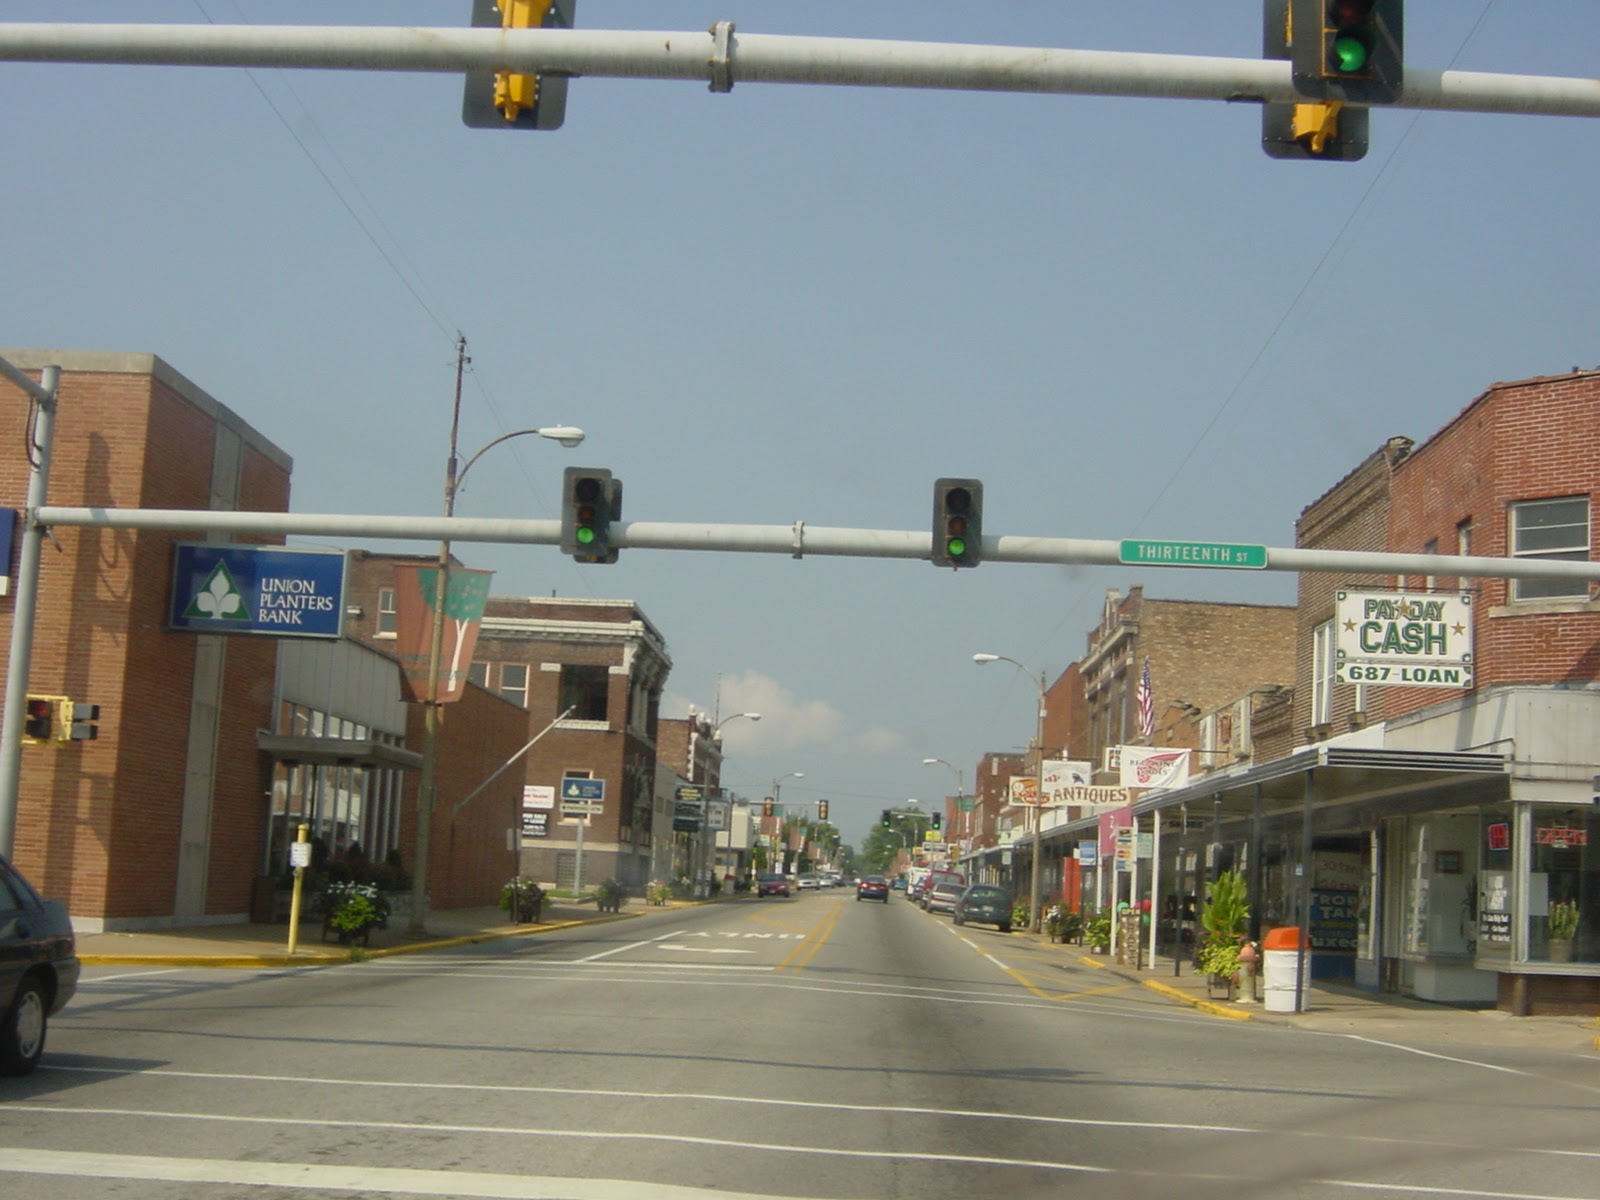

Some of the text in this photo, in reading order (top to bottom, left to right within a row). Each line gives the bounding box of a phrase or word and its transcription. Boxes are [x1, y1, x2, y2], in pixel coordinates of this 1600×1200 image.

[1138, 545, 1248, 563] THIRTEENTH ST
[262, 578, 315, 593] UNION
[260, 594, 333, 610] PLANTERS
[259, 610, 302, 624] BANK
[1360, 621, 1447, 655] CASH
[1053, 787, 1128, 805] ANTIQUES
[1536, 828, 1588, 846] OPEN
[1309, 893, 1358, 906] TROP
